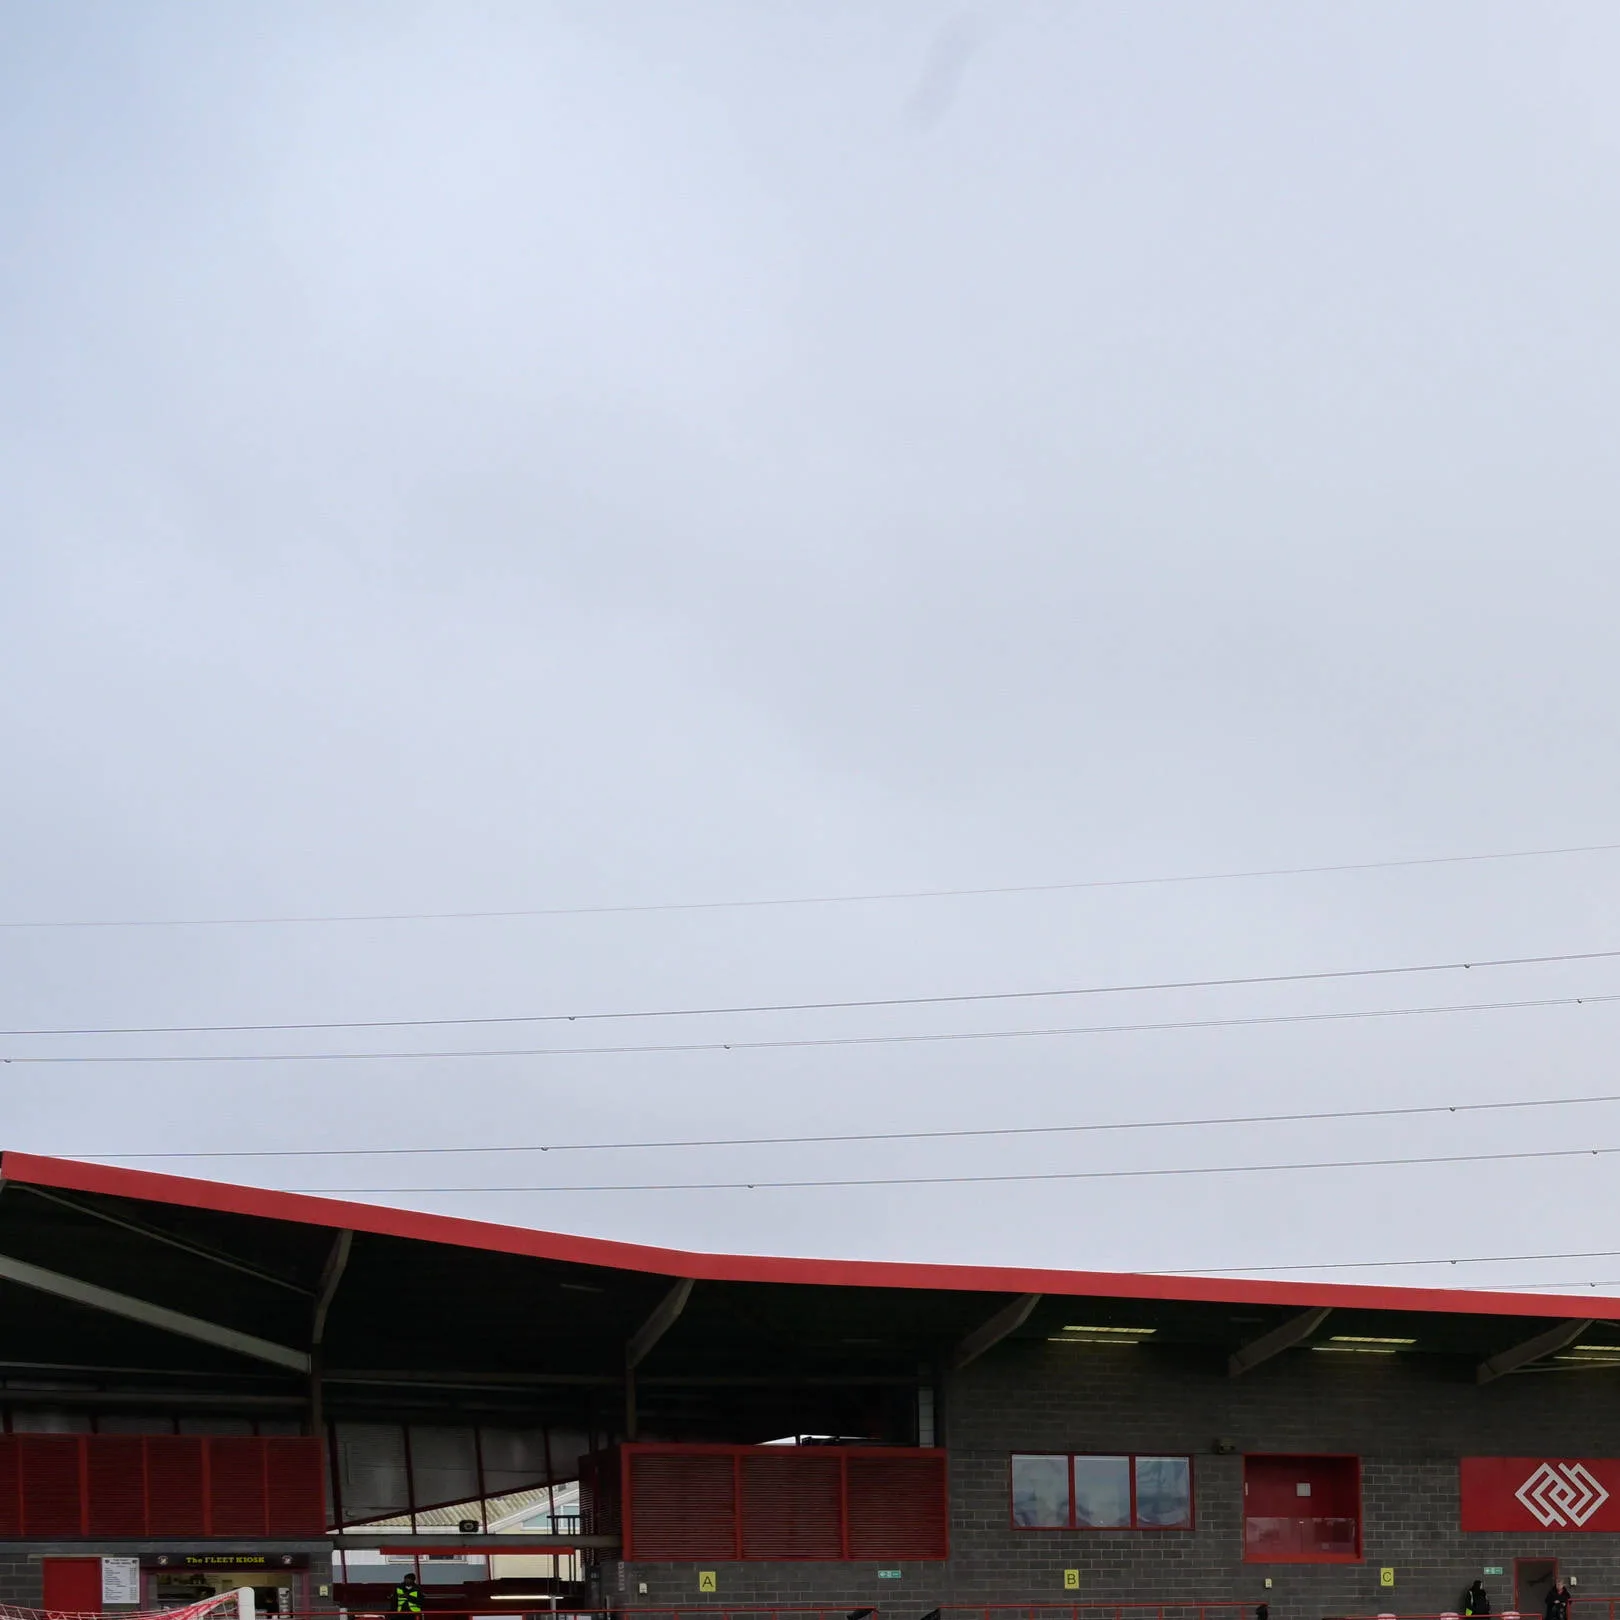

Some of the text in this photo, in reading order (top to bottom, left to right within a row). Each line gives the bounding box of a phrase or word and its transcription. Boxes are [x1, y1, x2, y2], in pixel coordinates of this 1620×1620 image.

[702, 1575, 714, 1587] A
[1066, 1573, 1077, 1586] B
[1381, 1571, 1392, 1583] C
